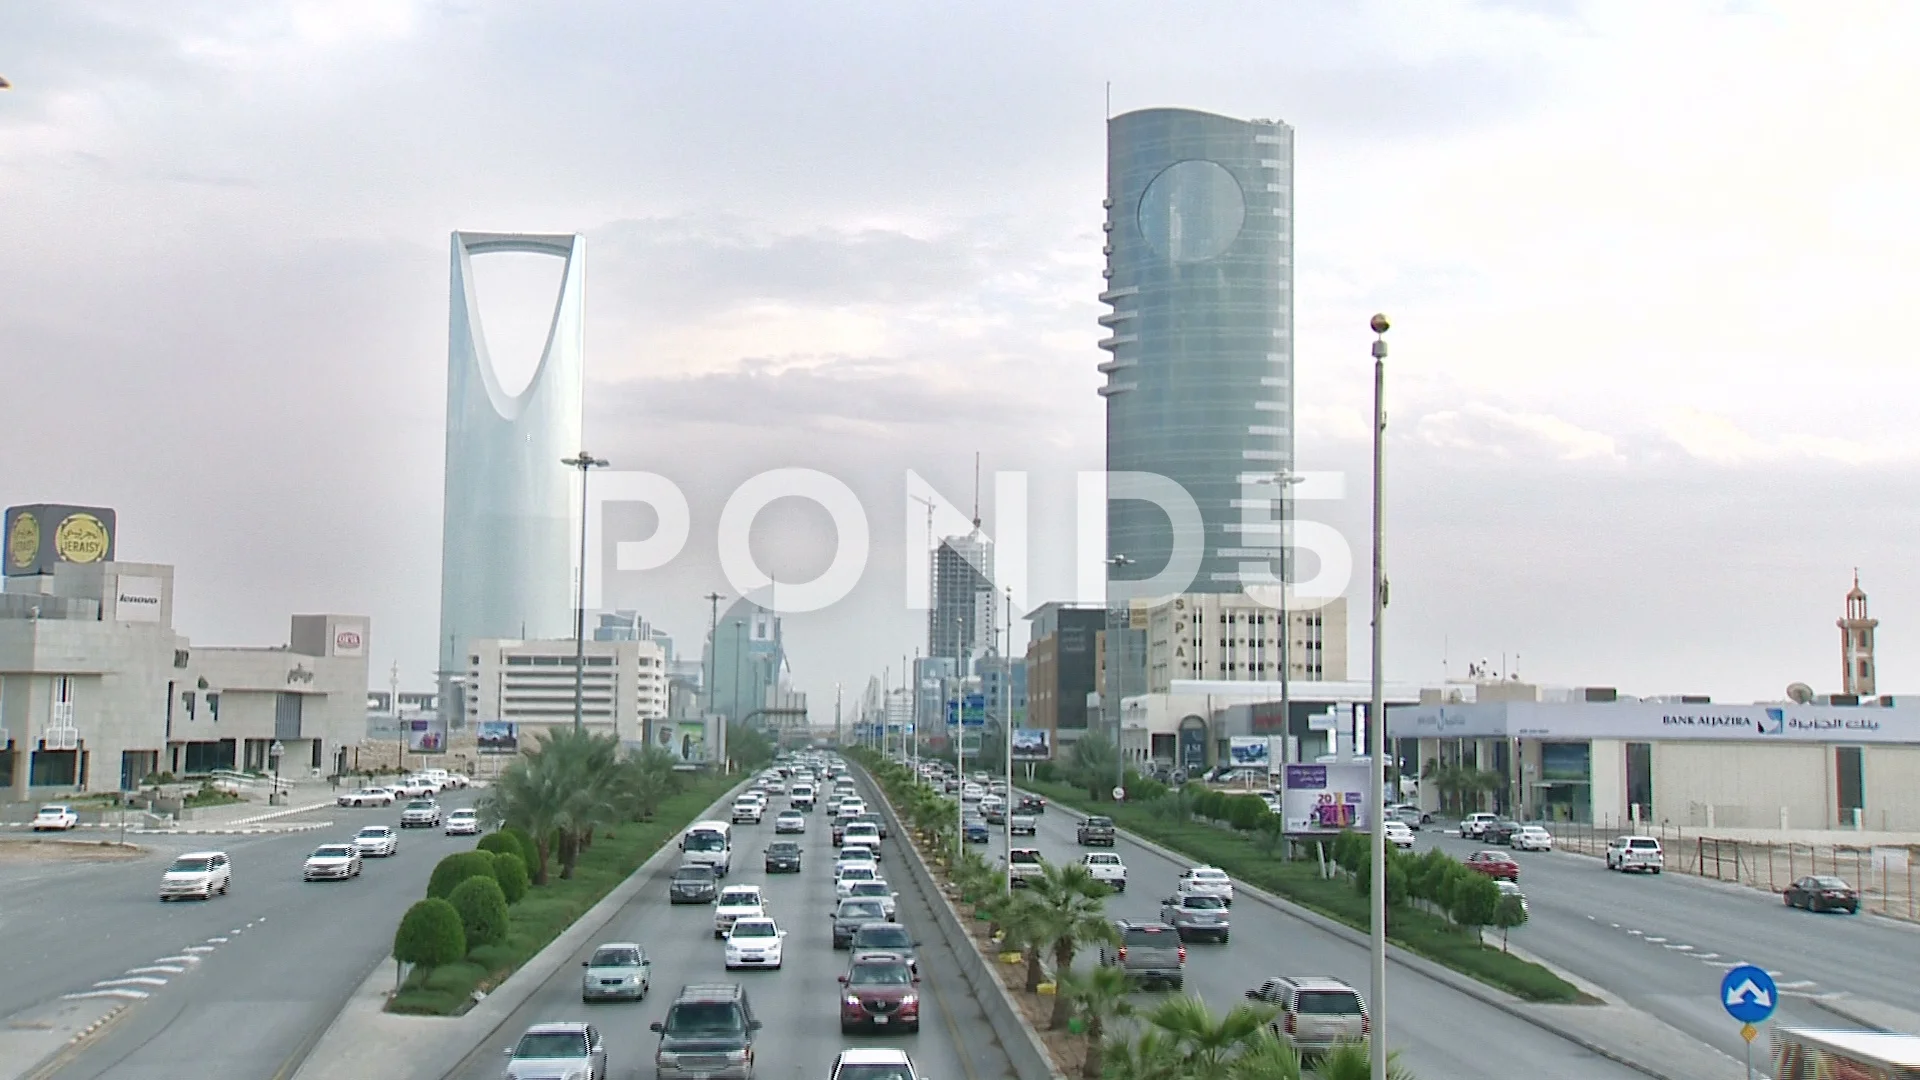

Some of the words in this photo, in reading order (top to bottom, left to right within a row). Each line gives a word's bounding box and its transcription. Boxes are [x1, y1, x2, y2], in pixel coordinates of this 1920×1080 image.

[64, 541, 100, 553] JERAISY
[120, 593, 157, 604] lenovo
[1662, 715, 1694, 725] BANK
[1697, 715, 1751, 727] ALJAZIRA
[1788, 717, 1842, 729] الجزيرة
[1845, 718, 1879, 730] بنك
